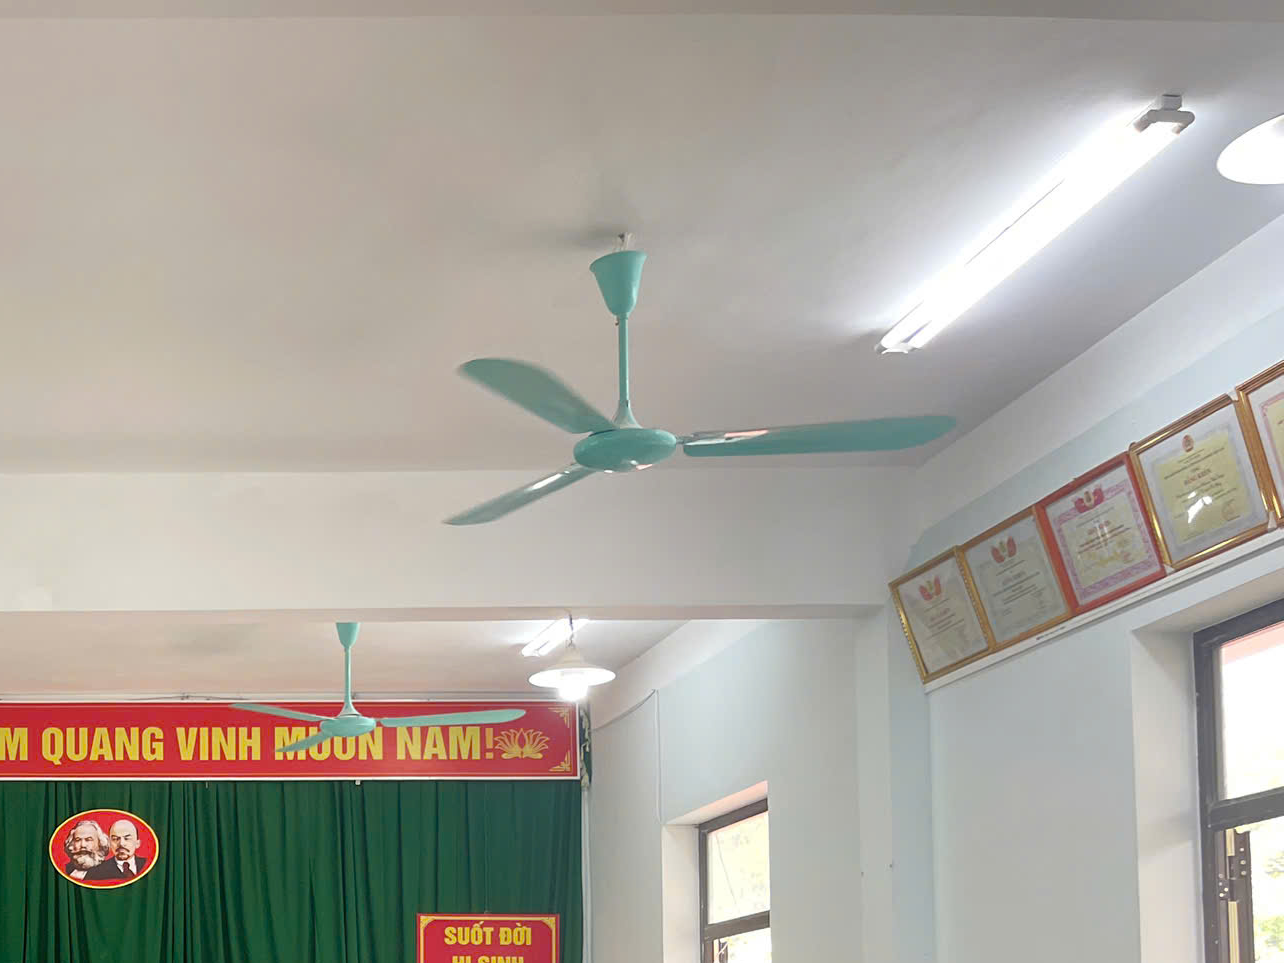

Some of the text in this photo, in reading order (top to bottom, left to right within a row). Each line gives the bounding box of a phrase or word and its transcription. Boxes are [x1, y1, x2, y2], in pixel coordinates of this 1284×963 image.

[42, 727, 164, 765] QUANG
[176, 727, 261, 760] VINH
[396, 727, 493, 760] NAM!
[444, 921, 532, 945] SUỐT ĐỜI
